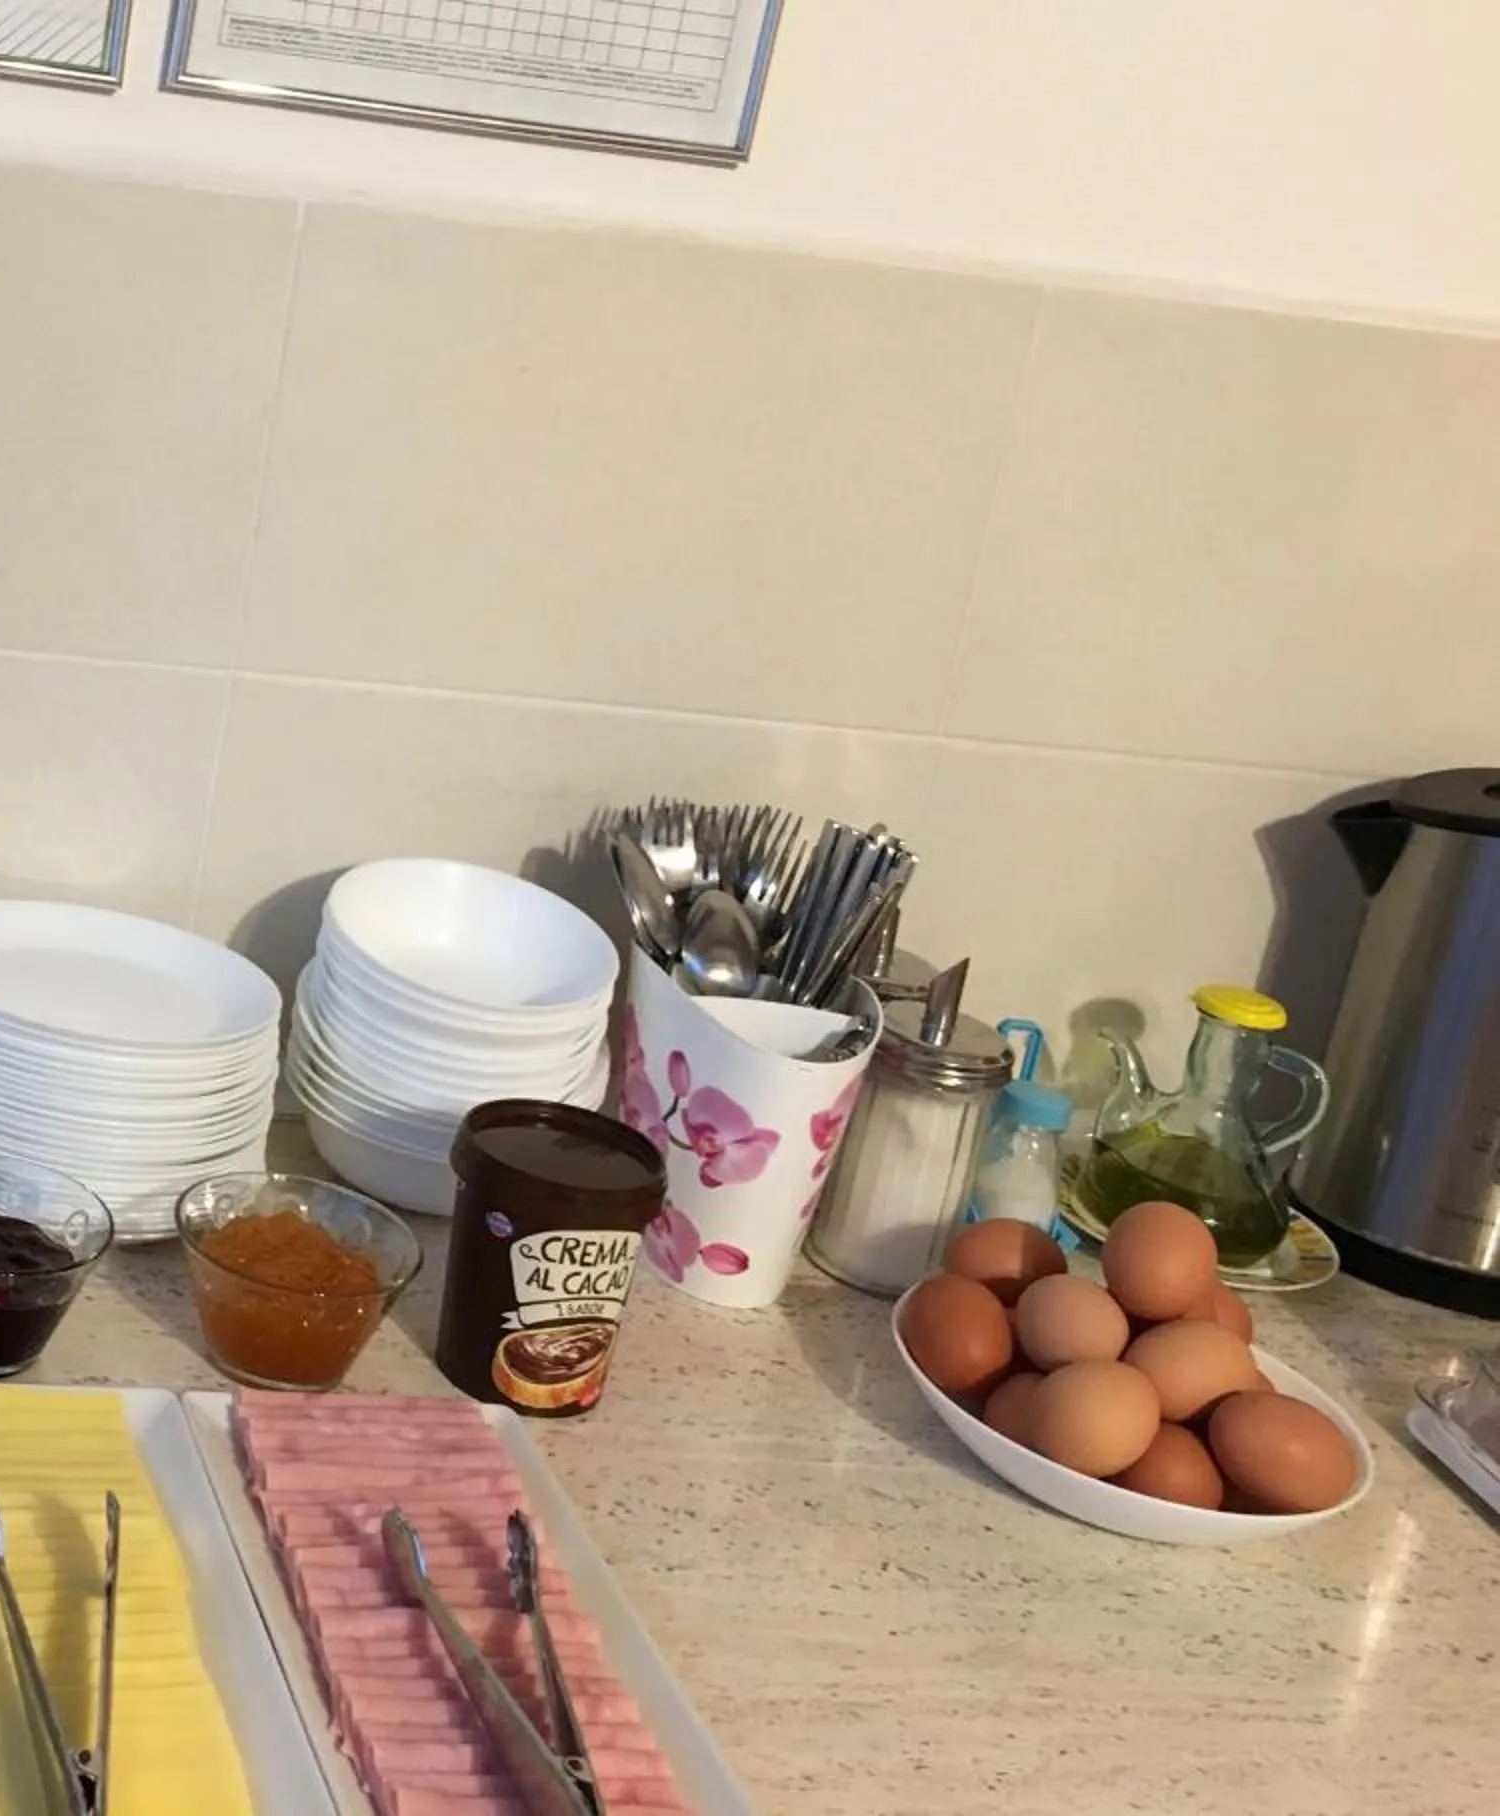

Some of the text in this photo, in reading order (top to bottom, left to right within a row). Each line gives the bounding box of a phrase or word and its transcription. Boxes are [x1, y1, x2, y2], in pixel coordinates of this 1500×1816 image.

[540, 1236, 630, 1267] CREMA
[525, 1265, 629, 1295] AL CACAO
